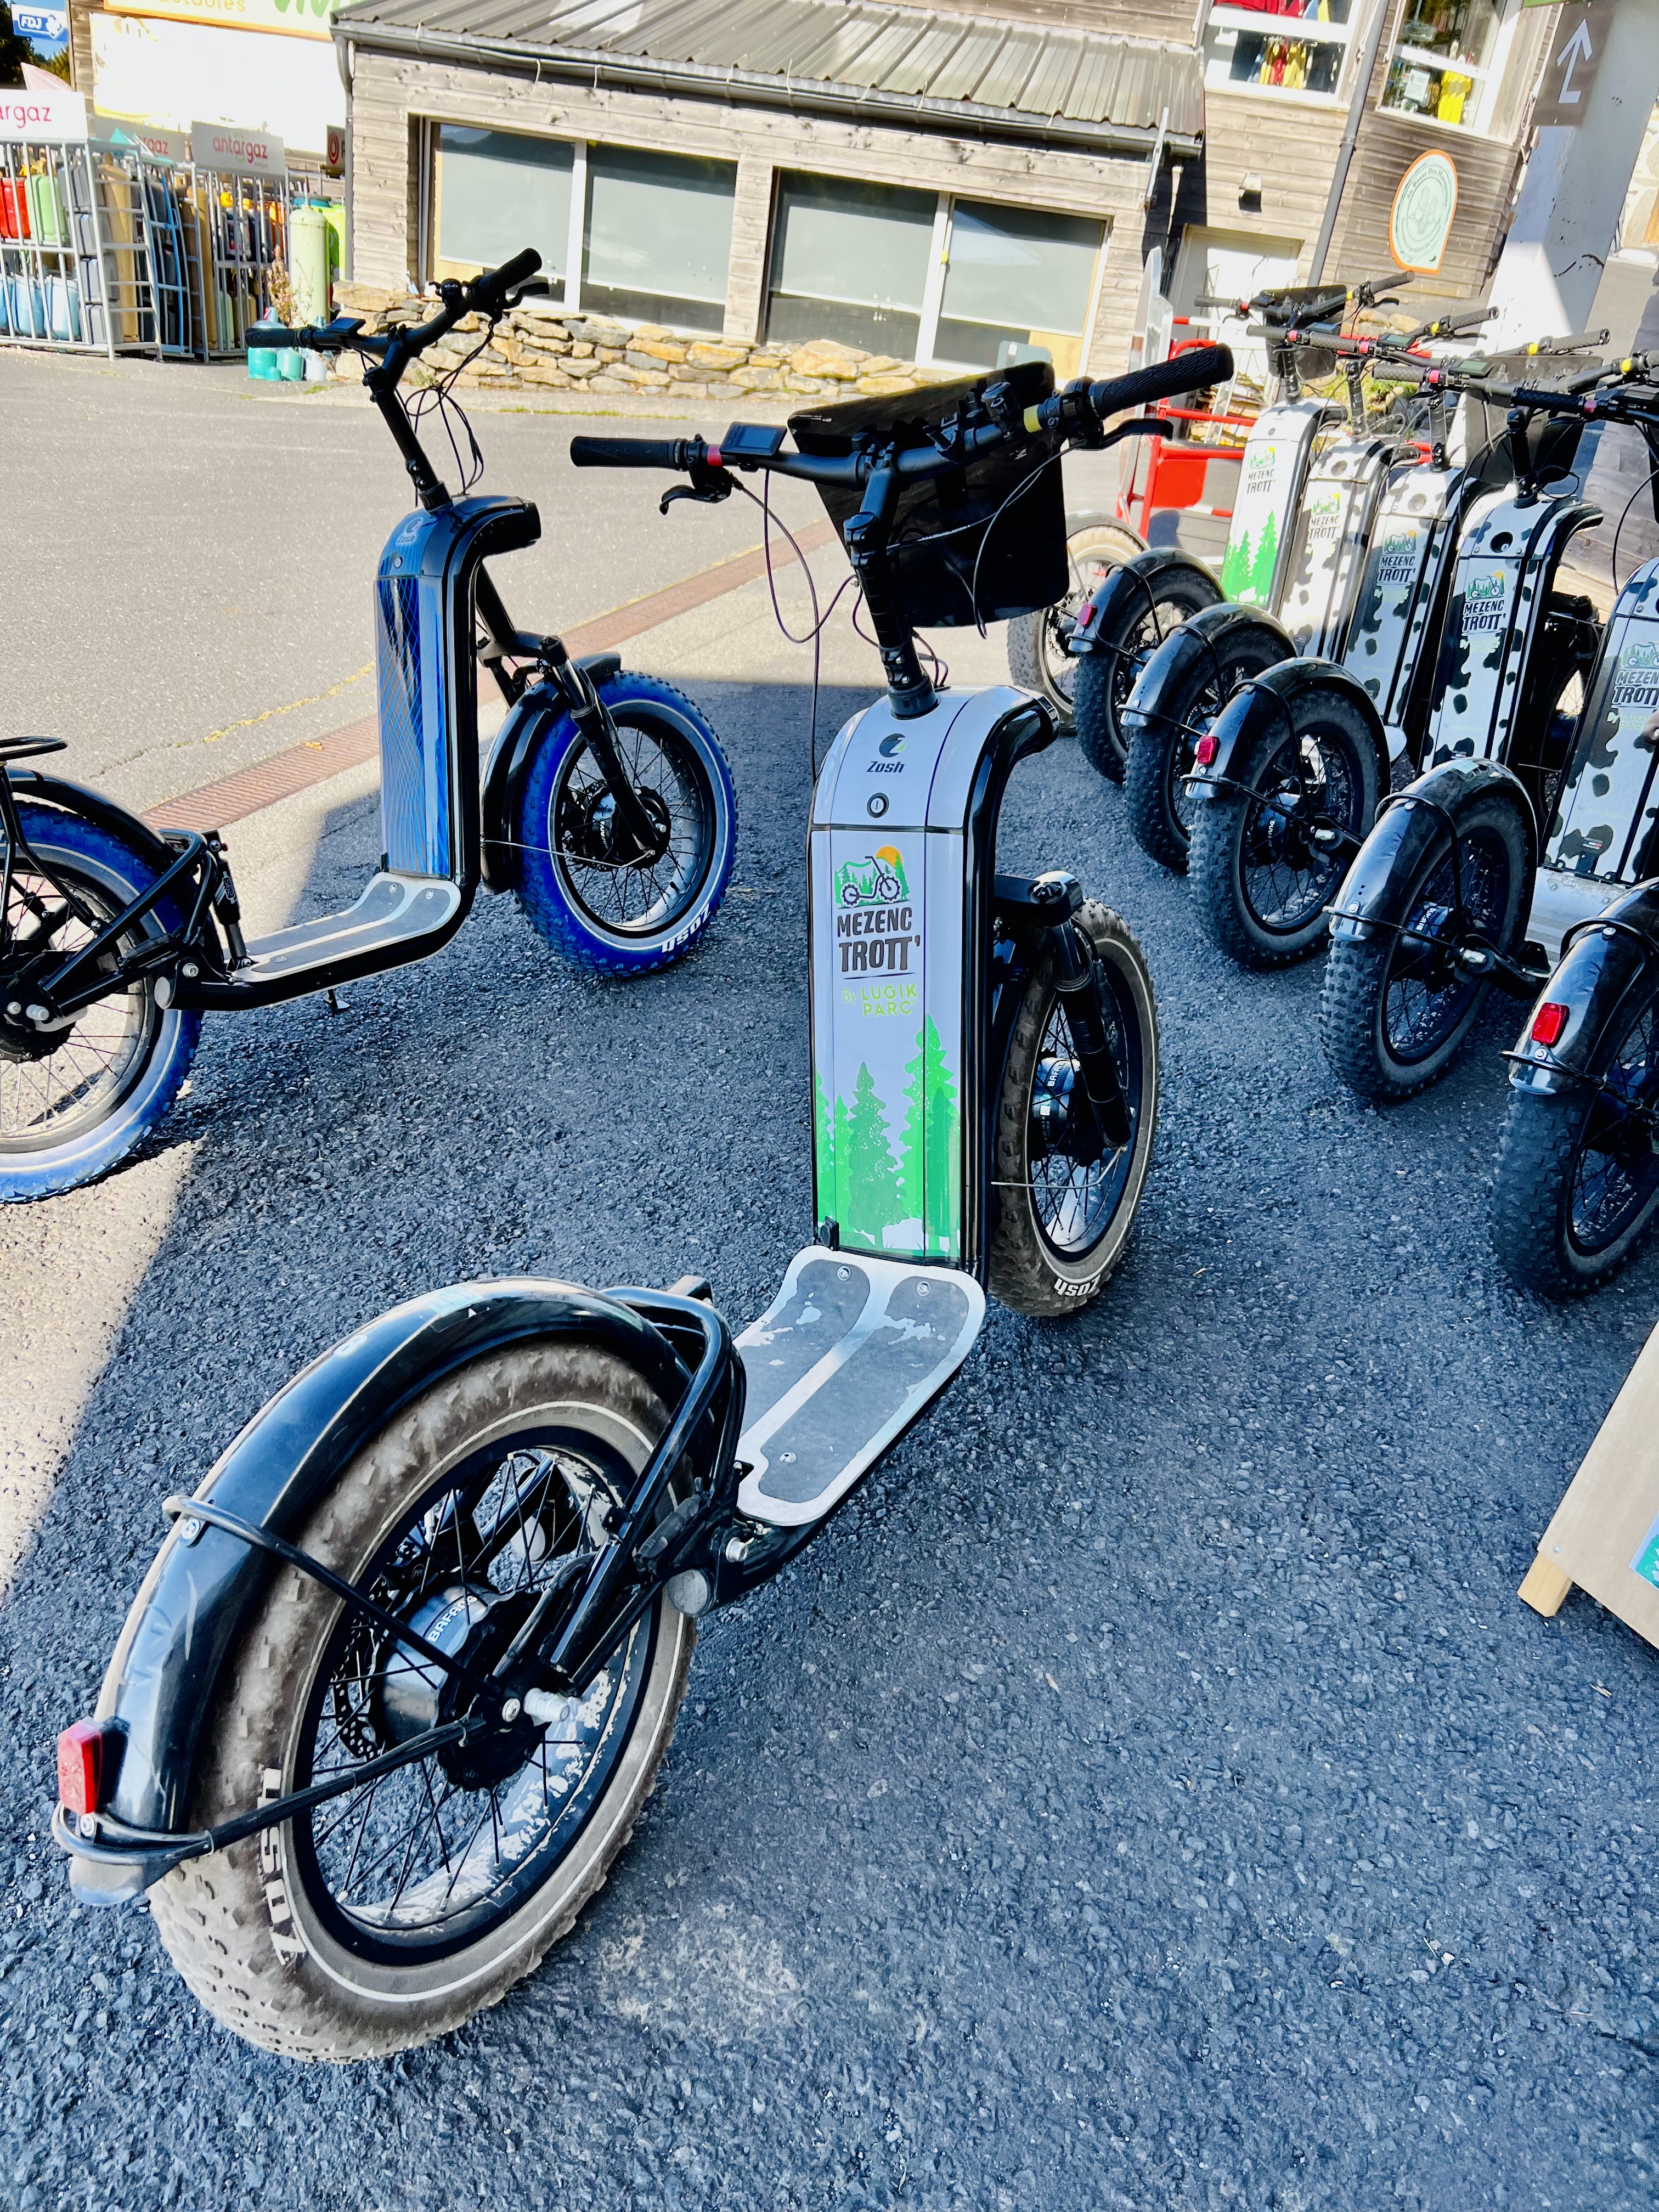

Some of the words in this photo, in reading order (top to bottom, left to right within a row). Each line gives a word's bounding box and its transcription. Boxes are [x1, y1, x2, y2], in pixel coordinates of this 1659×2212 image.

[21, 15, 42, 30] FDJ
[212, 135, 268, 163] antargaz
[1248, 468, 1275, 481] MEZENC
[1310, 515, 1340, 527] MEZENC
[397, 535, 415, 543] Zosh
[1380, 555, 1415, 567] MEZENC
[1464, 600, 1504, 614] MEZENC
[866, 761, 905, 773] Zosh
[837, 907, 912, 938] MEZENC
[839, 935, 921, 972] TROTT'
[843, 988, 857, 1005] By
[861, 983, 918, 1001] LUGIK
